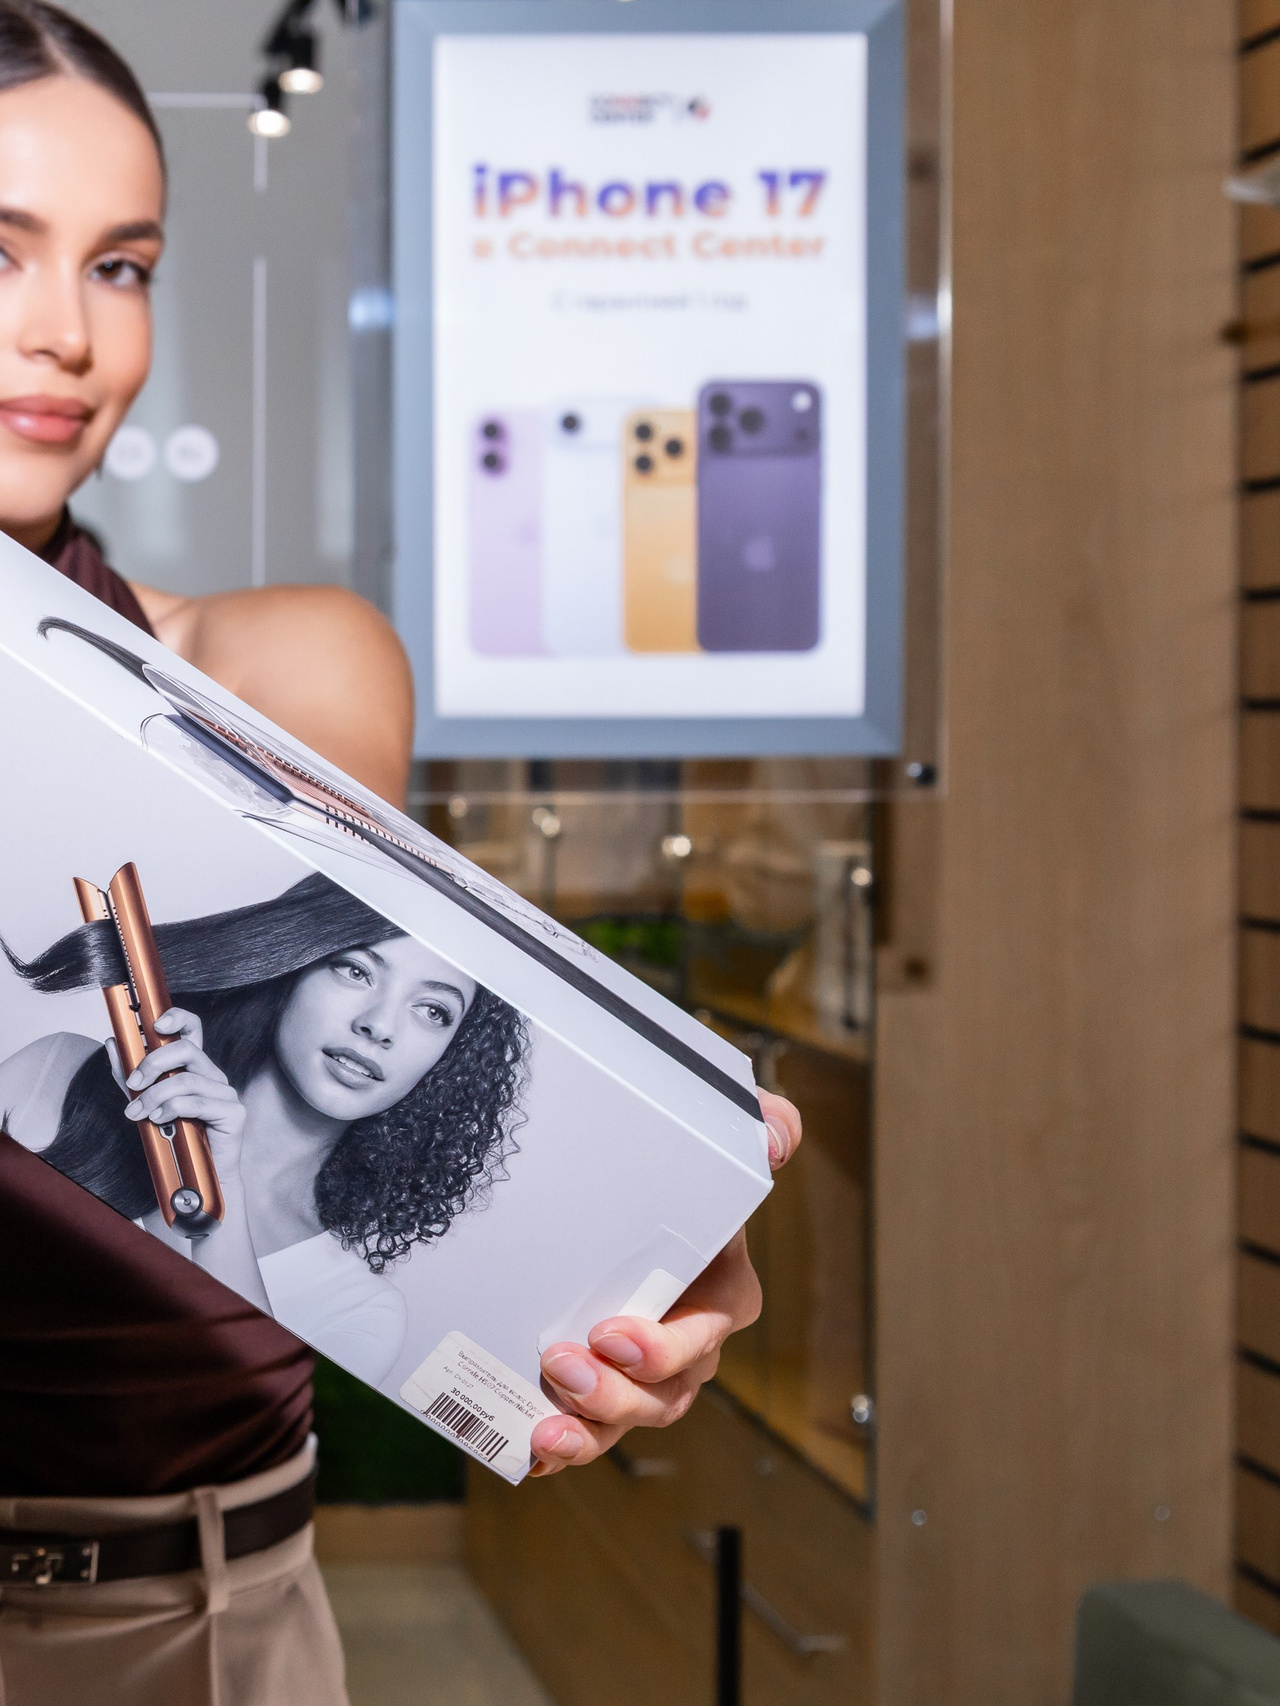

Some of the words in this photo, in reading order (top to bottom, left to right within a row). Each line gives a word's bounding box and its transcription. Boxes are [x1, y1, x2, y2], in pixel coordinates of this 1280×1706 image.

[474, 166, 731, 218] iPhone
[757, 169, 828, 218] 17
[508, 232, 677, 260] Connect
[691, 232, 826, 260] Center
[458, 1361, 479, 1379] Corrale
[450, 1387, 461, 1396] 30
[526, 1401, 545, 1417] Dyson
